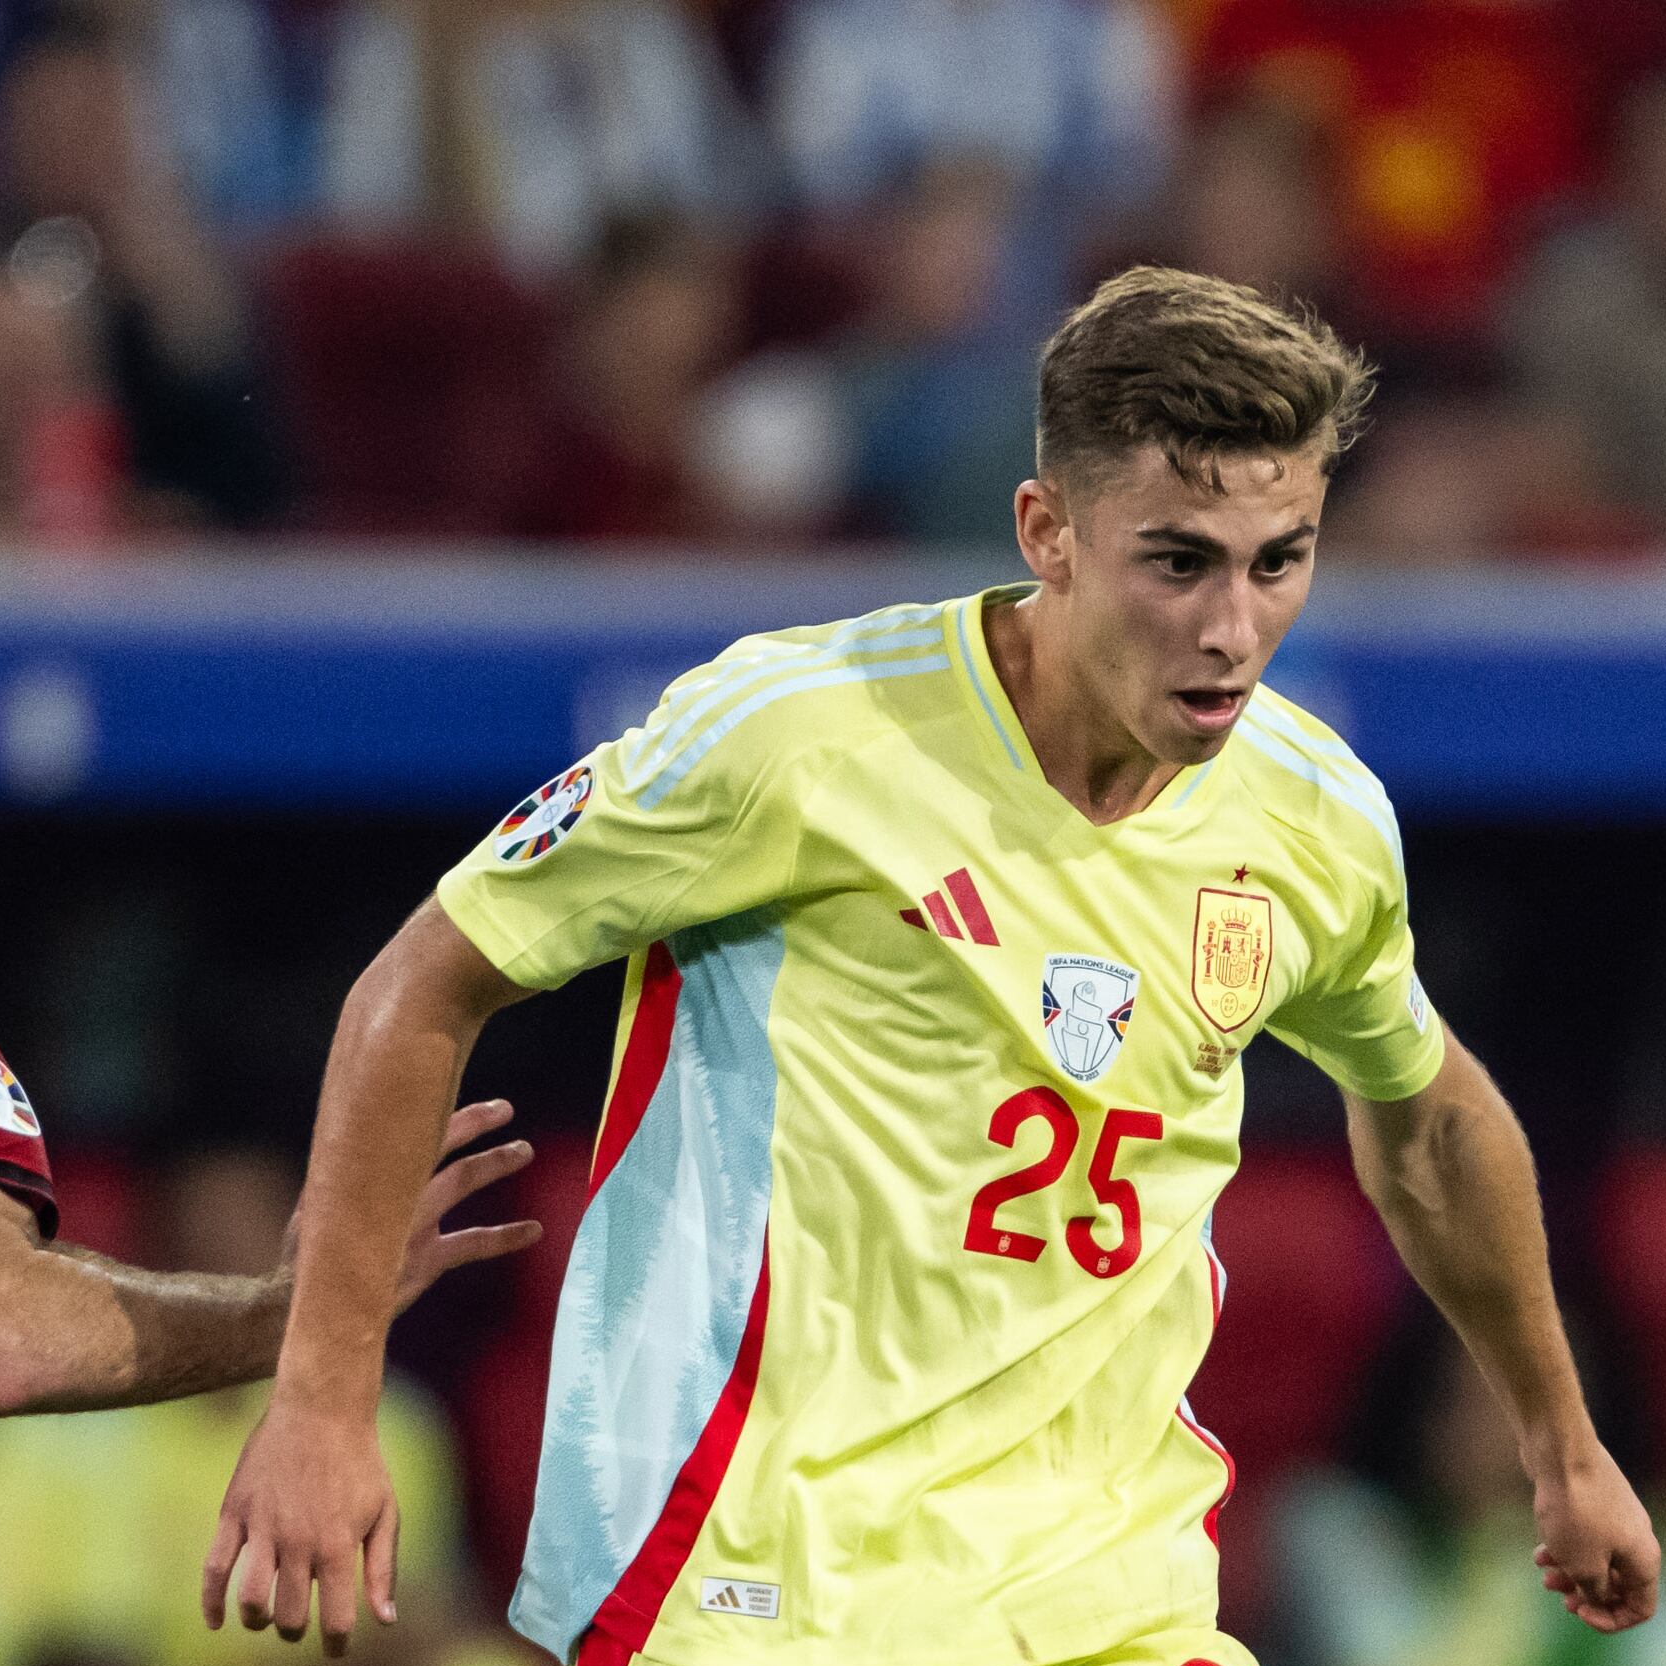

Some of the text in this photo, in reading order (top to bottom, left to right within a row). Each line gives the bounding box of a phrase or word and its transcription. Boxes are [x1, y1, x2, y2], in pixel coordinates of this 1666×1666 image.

[1049, 957, 1136, 981] UEFA NATIONS LEAGUE
[963, 1085, 1163, 1279] 25
